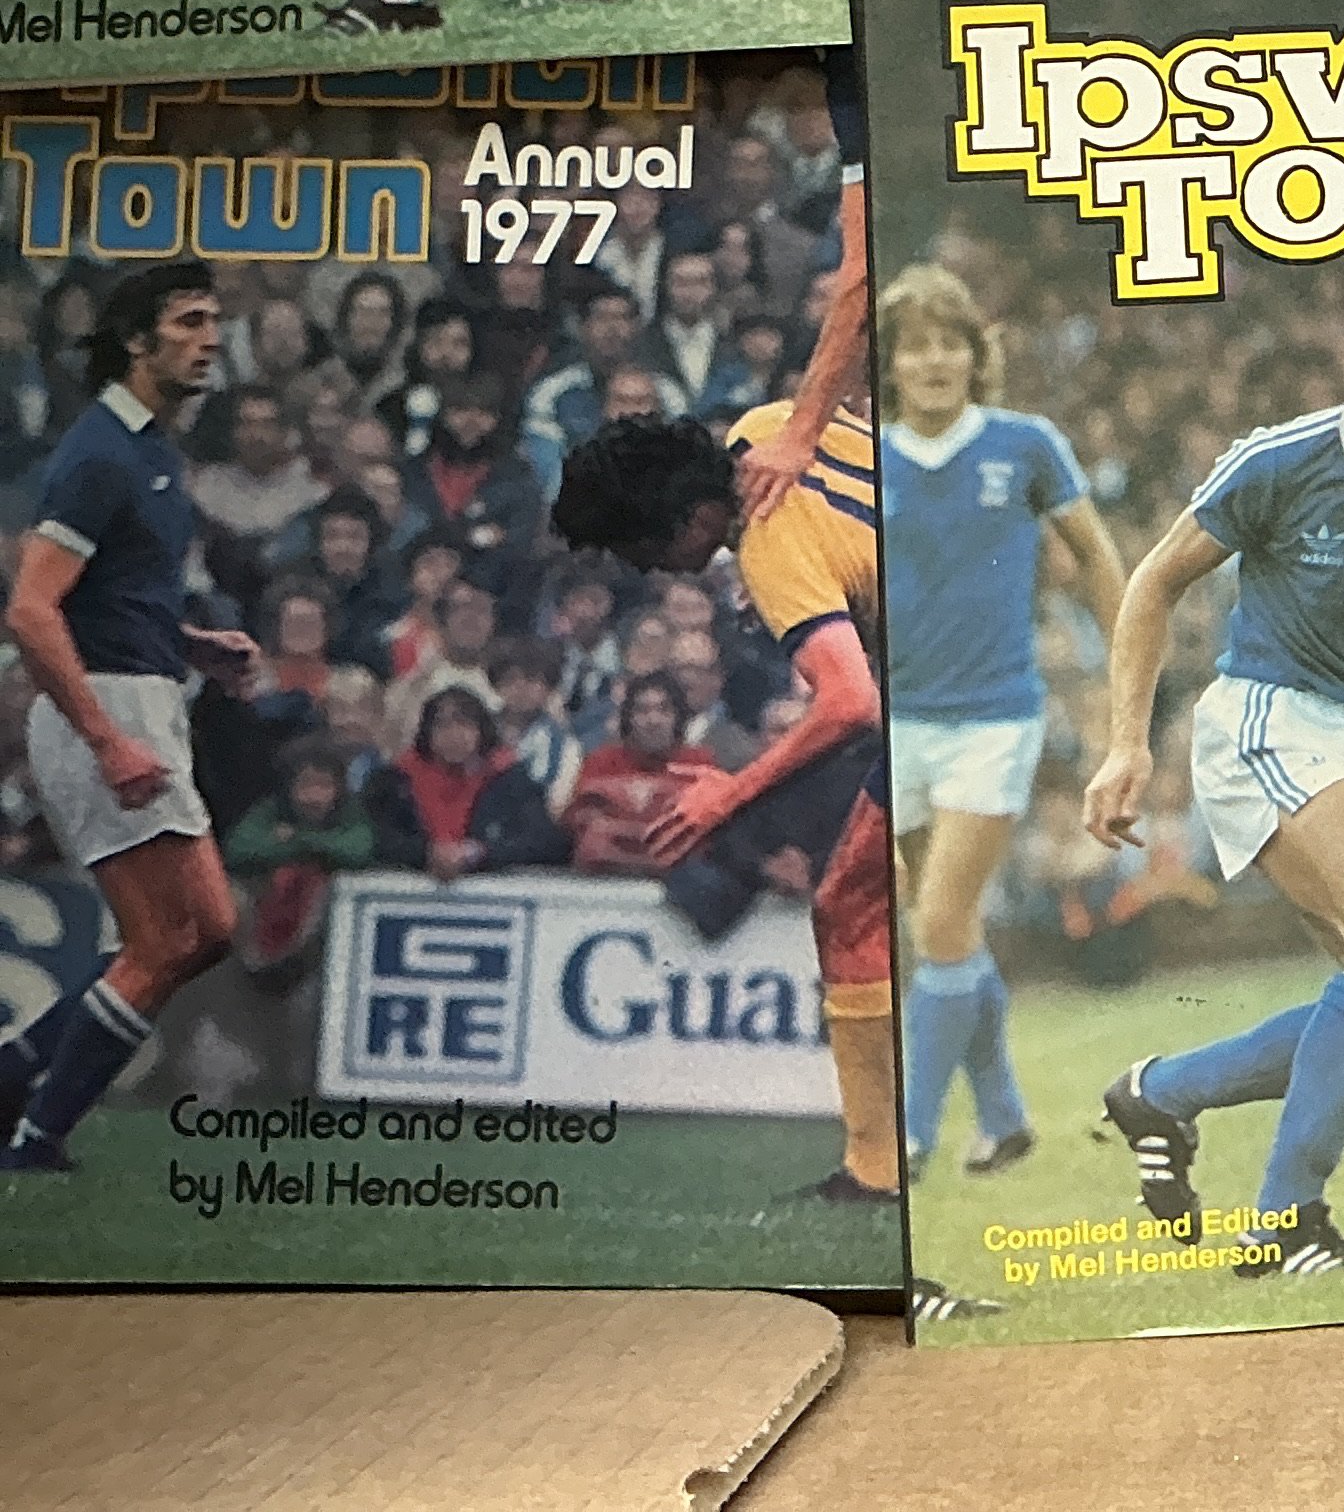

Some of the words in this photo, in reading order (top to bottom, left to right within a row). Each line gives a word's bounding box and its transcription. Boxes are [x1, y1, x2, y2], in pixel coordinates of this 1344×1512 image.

[462, 122, 695, 190] Annual
[3, 116, 432, 262] Town
[461, 199, 619, 265] 1977
[169, 1096, 367, 1149] Compiled
[377, 1099, 464, 1142] and
[474, 1100, 618, 1145] edited
[169, 1161, 223, 1218] by
[235, 1162, 314, 1207] Mel
[325, 1161, 560, 1209] Henderson
[983, 1219, 1129, 1253] Compiled
[1136, 1212, 1194, 1240] and
[1201, 1204, 1299, 1236] Edited
[1004, 1257, 1040, 1286] by
[1049, 1252, 1108, 1279] Mel
[1114, 1240, 1282, 1274] Henderson
